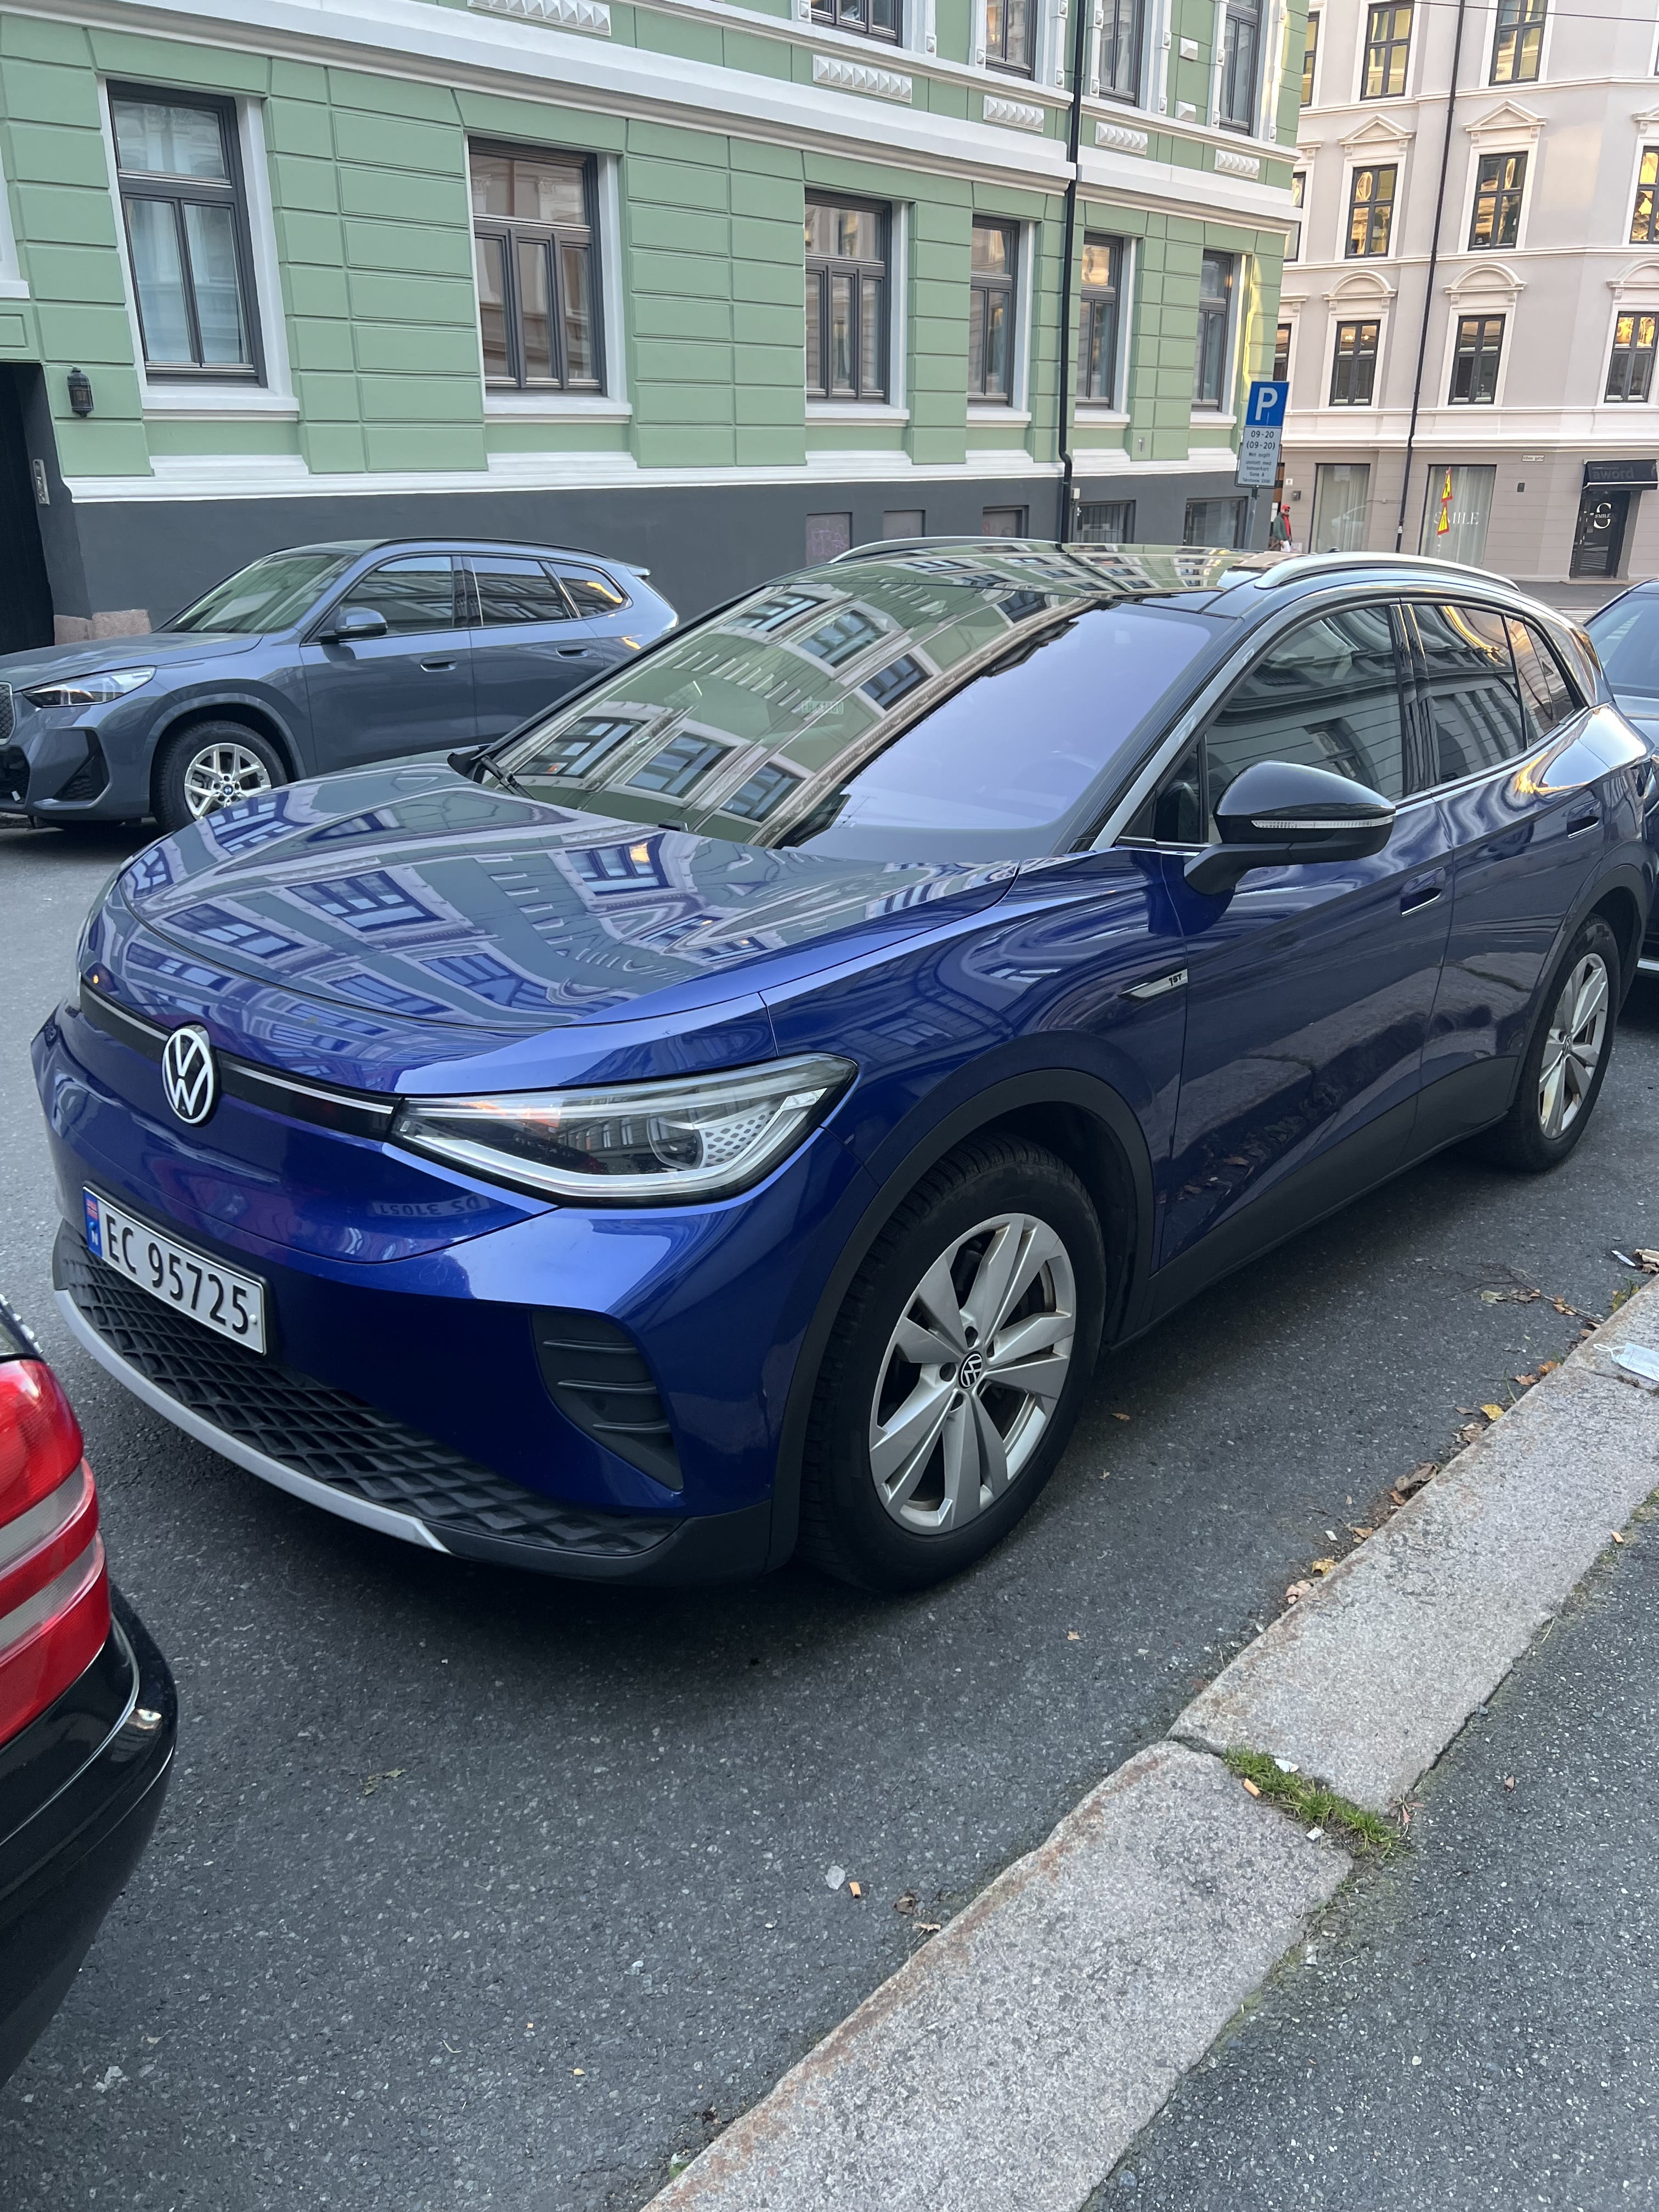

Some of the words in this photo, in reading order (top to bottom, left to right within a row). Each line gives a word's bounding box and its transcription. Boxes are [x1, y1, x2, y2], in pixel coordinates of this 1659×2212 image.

[1255, 387, 1278, 421] P
[1251, 430, 1274, 438] 09-20
[1246, 441, 1276, 450] (09-20)
[1169, 973, 1182, 986] 1ST
[106, 1211, 137, 1275] EC
[148, 1242, 249, 1335] 95725
